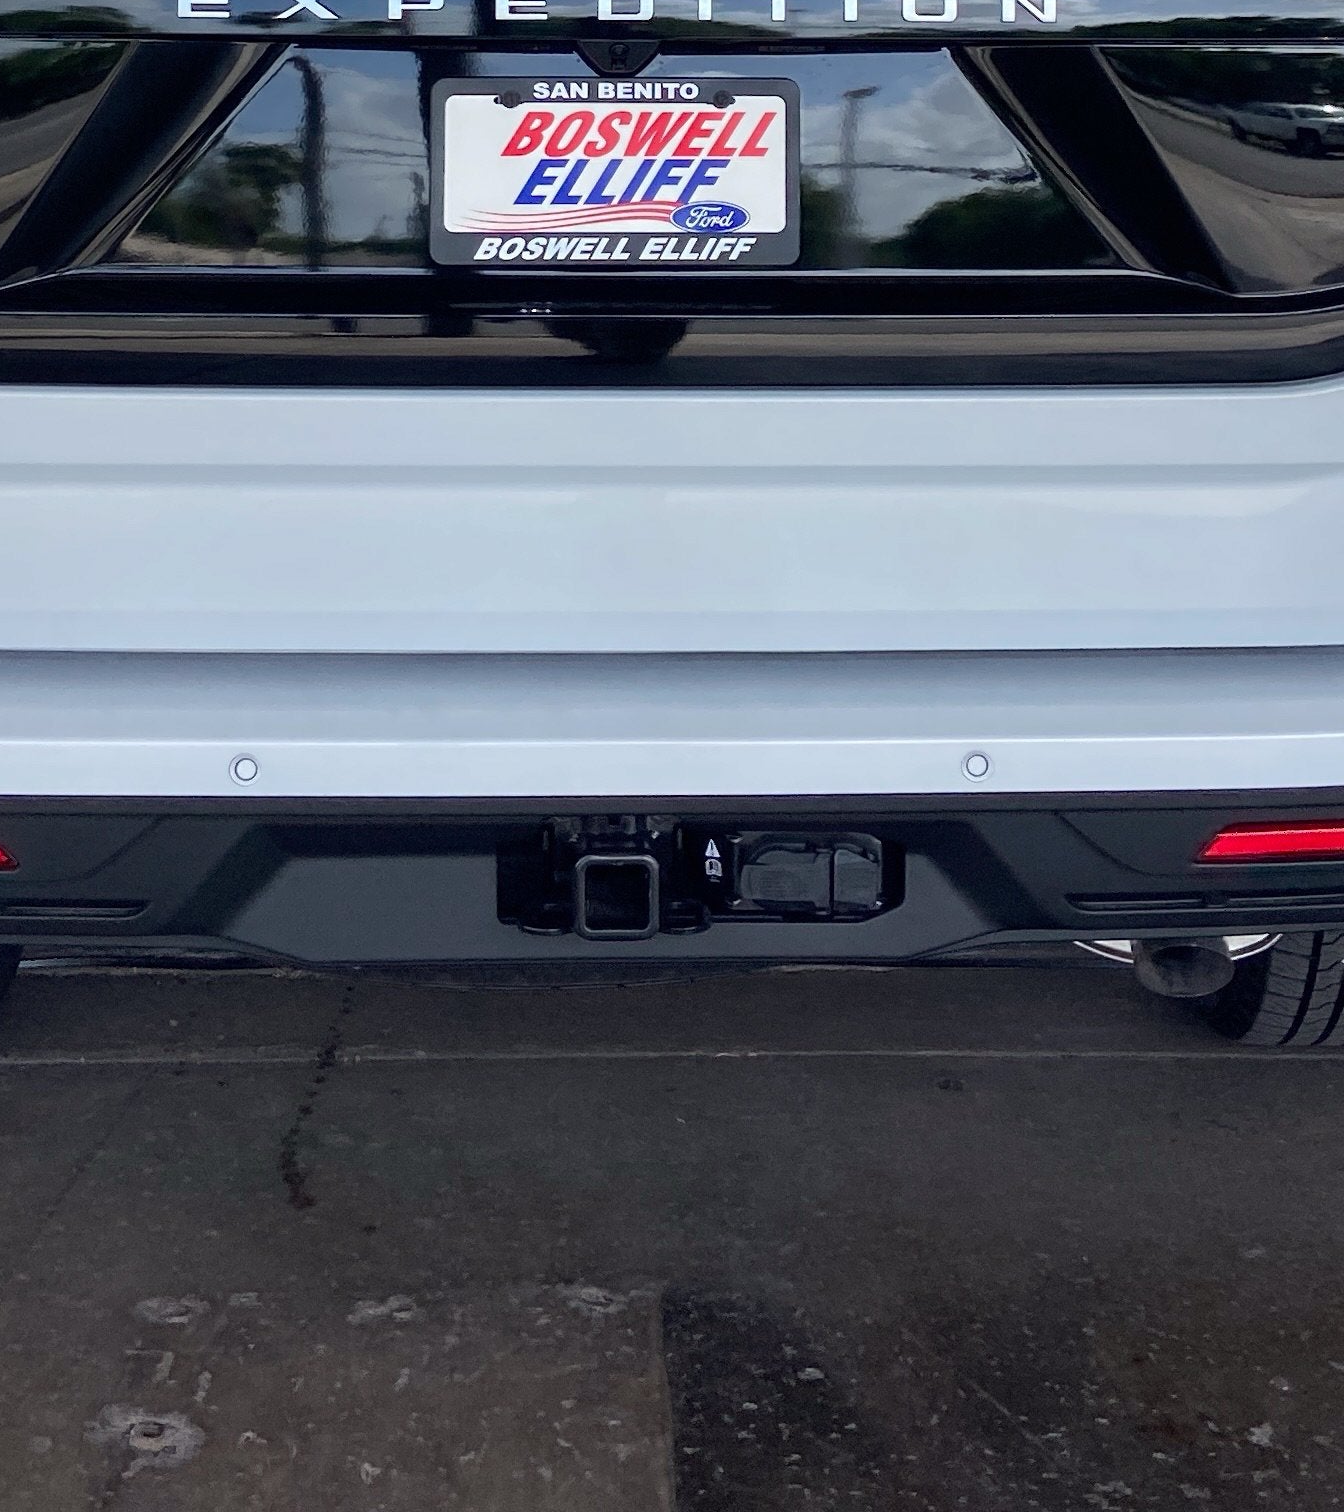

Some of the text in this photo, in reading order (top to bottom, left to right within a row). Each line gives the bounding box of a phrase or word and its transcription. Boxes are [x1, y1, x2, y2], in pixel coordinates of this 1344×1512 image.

[533, 82, 699, 100] SAN BENITO
[500, 111, 778, 158] BOSWELL
[512, 158, 732, 206] ELLIFF
[684, 205, 736, 230] Ford
[472, 236, 758, 261] BOSWELL ELLIFF
